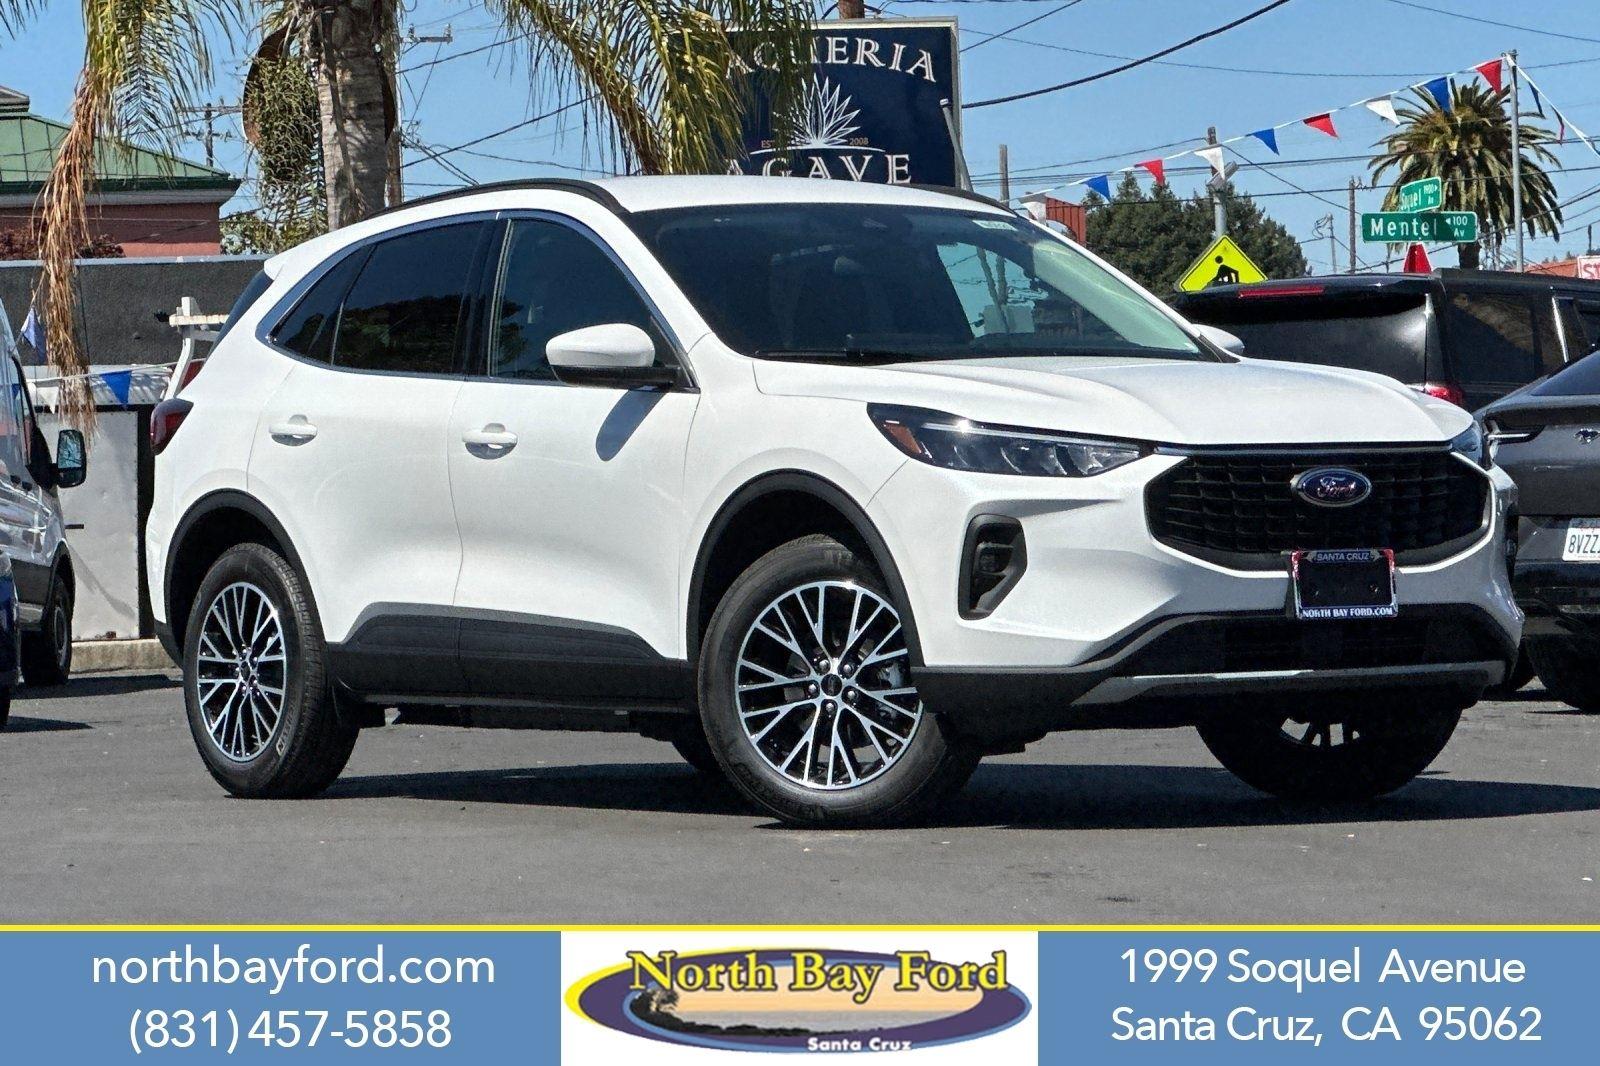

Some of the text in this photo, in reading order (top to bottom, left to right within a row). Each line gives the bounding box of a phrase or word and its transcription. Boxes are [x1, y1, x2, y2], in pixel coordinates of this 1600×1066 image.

[1452, 216, 1468, 226] 100
[1370, 218, 1437, 237] Mentel
[1453, 228, 1465, 237] Av
[1316, 476, 1356, 498] Ford
[1568, 534, 1600, 554] 8VZZ
[1317, 552, 1370, 561] SANTA CRUZ
[1302, 607, 1393, 618] NORTH BAY FORD.COM
